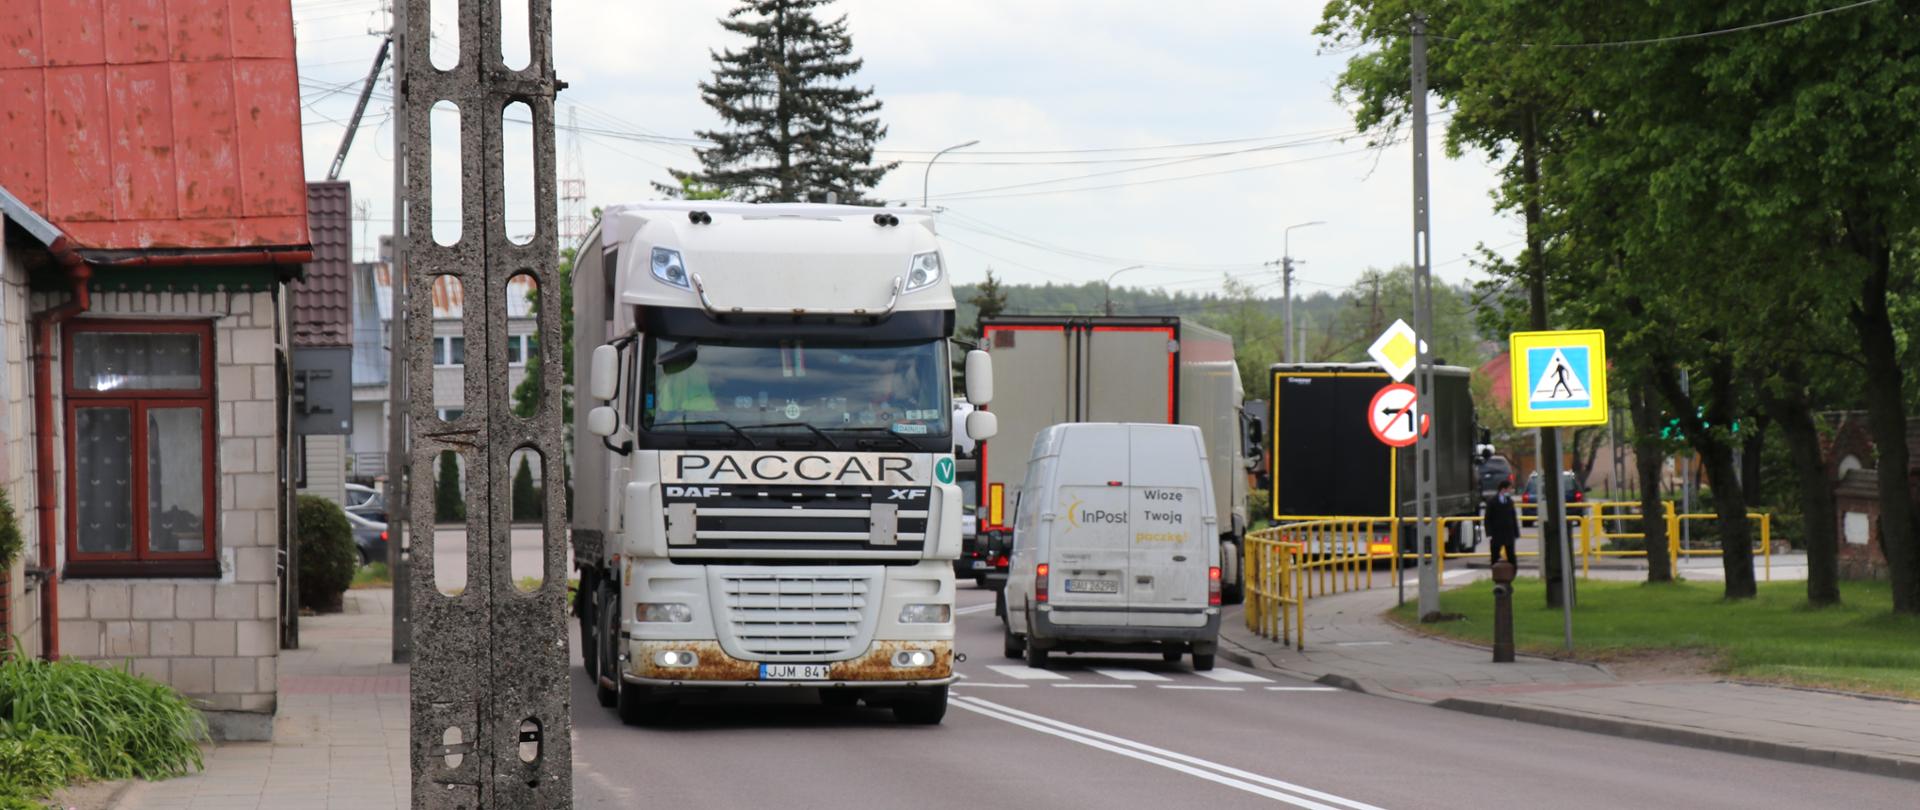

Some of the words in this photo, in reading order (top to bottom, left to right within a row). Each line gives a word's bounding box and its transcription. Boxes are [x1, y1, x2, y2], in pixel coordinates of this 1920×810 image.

[676, 455, 915, 482] PACCAR
[941, 462, 952, 479] V
[666, 486, 720, 498] DAF
[888, 489, 927, 500] XF
[1082, 510, 1128, 524] InPost
[1144, 510, 1183, 524] Twoją
[768, 665, 796, 677] JJM
